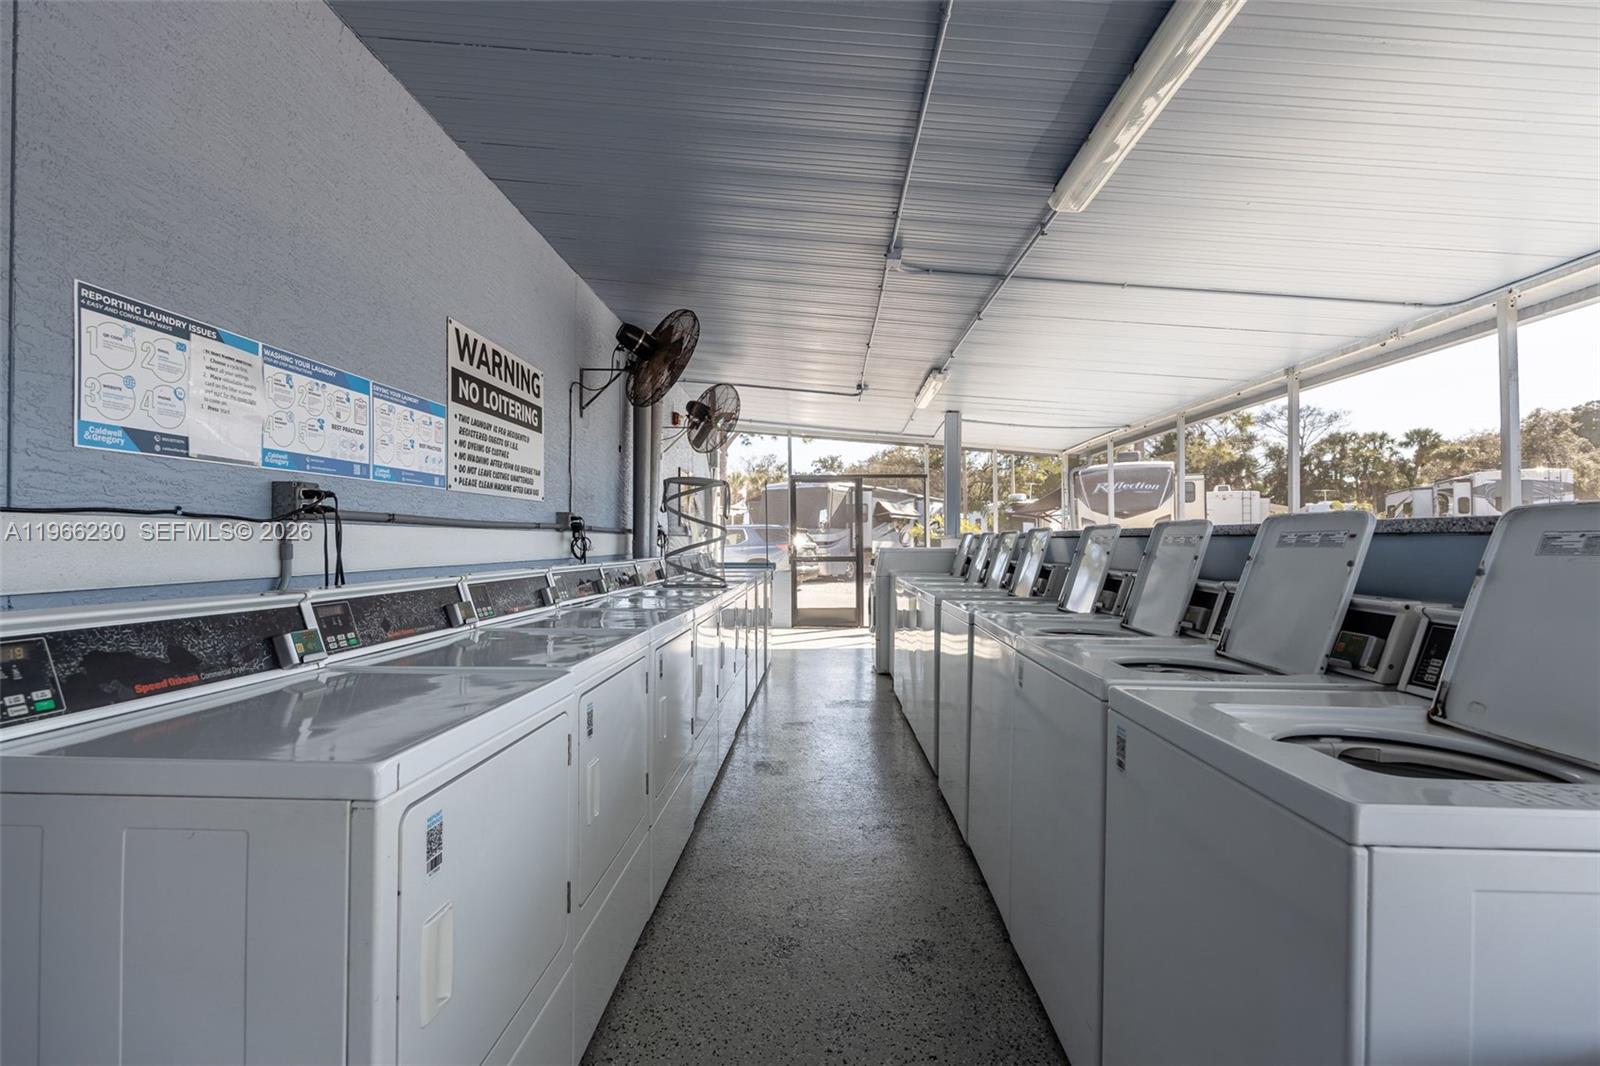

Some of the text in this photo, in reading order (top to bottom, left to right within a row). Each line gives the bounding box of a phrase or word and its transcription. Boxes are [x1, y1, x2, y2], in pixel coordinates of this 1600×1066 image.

[81, 288, 218, 339] REPORTING LAUNDRY ISSUES
[86, 300, 104, 310] EASY
[104, 306, 118, 314] AND
[119, 311, 156, 326] CONVENIENT
[156, 322, 172, 331] WAYS
[264, 348, 293, 364] WASHING
[294, 358, 311, 369] YOUR
[454, 327, 540, 398] WARNING
[458, 377, 539, 427] NO LOITERING
[88, 426, 122, 438] Caldwell
[458, 413, 470, 424] THIS
[470, 418, 492, 431] LAUNDRY
[498, 426, 506, 436] FOR
[458, 426, 488, 440] REGISTERED
[458, 439, 467, 448] NO
[485, 446, 491, 454] OF
[491, 448, 510, 459] CLOTHES
[458, 452, 467, 460] NO
[467, 454, 489, 466] WASHING
[490, 458, 503, 470] AFTER
[458, 464, 534, 486] DO NOT LEAVE CLOTHES UNATTENDED
[458, 477, 478, 488] PLEASE
[478, 480, 494, 490] CLEAN
[494, 482, 512, 492] MACHINE
[134, 679, 168, 694] Speed
